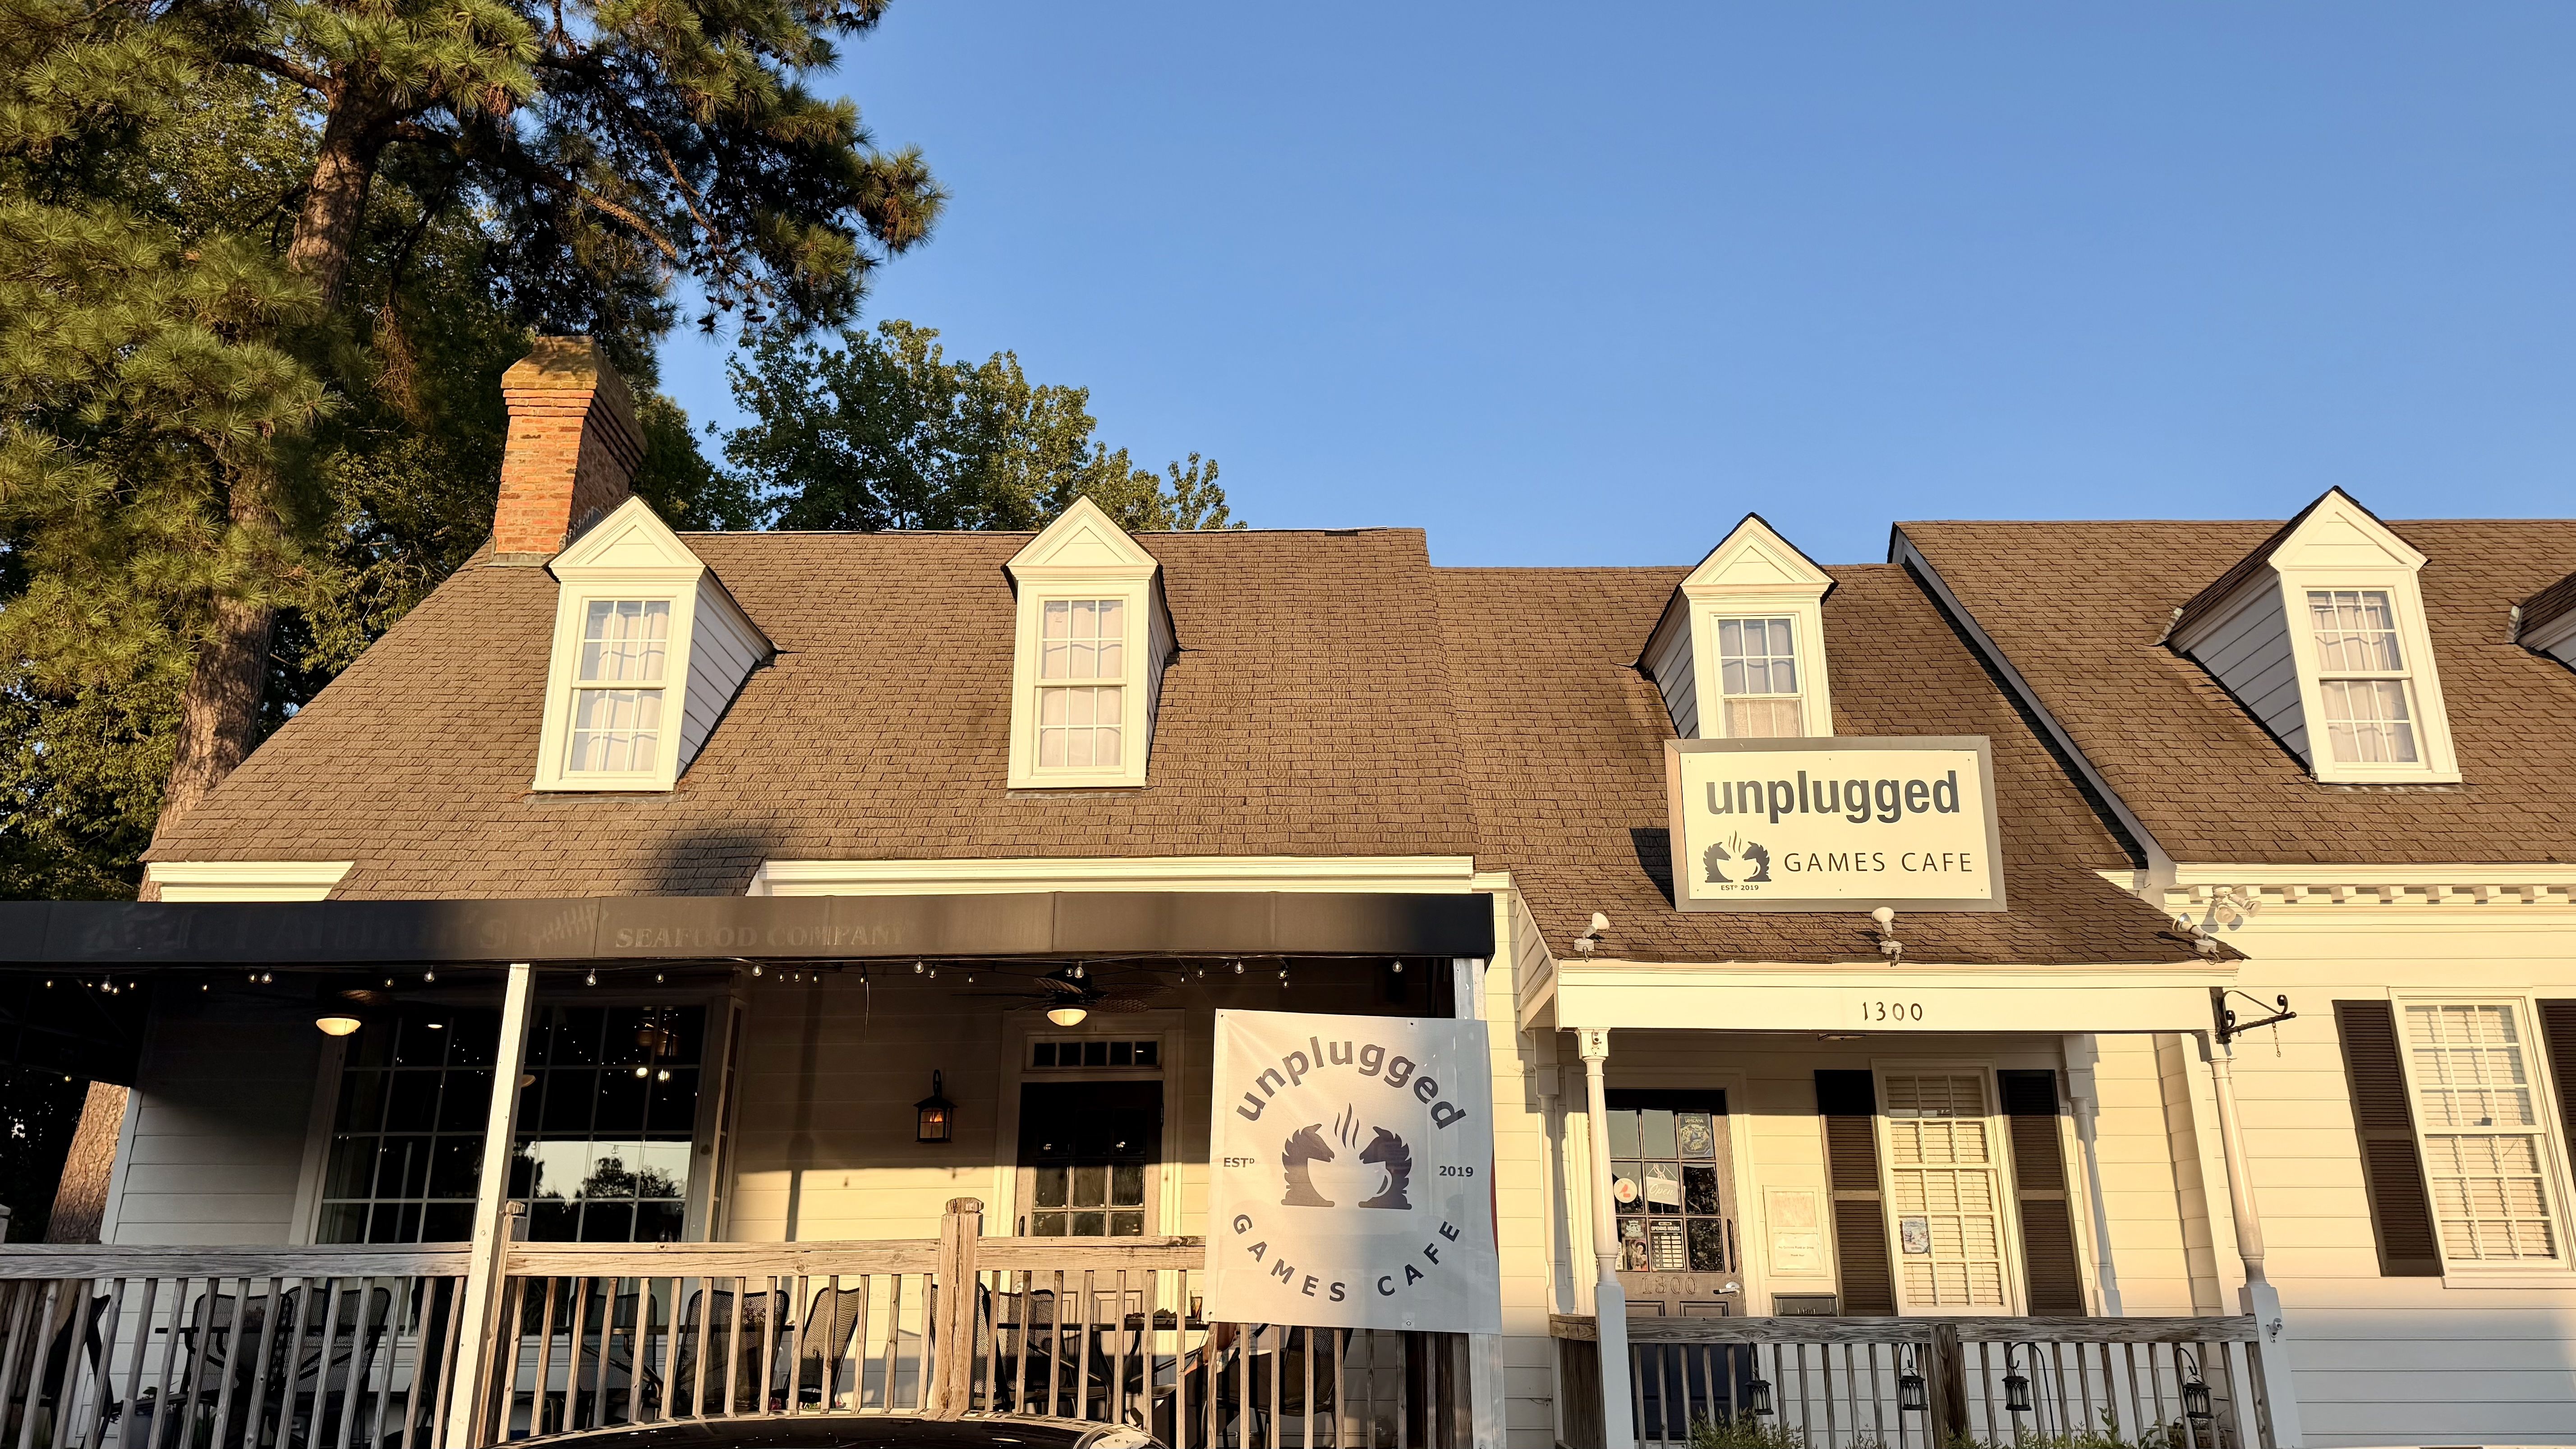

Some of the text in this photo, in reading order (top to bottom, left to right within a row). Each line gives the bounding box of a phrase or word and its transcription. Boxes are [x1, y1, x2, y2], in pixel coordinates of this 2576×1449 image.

[1706, 770, 1960, 824] unplugged
[1785, 852, 1973, 873] GAMES CAFE
[615, 925, 906, 947] SEAFOOD COMPANY
[1863, 1002, 1923, 1021] 1300
[1236, 1036, 1466, 1130] unplugged
[1439, 1165, 1474, 1178] 2019
[1649, 1183, 1675, 1196] Open
[1233, 1214, 1460, 1302] GAMES CAFE
[1642, 1276, 1697, 1295] 1300
